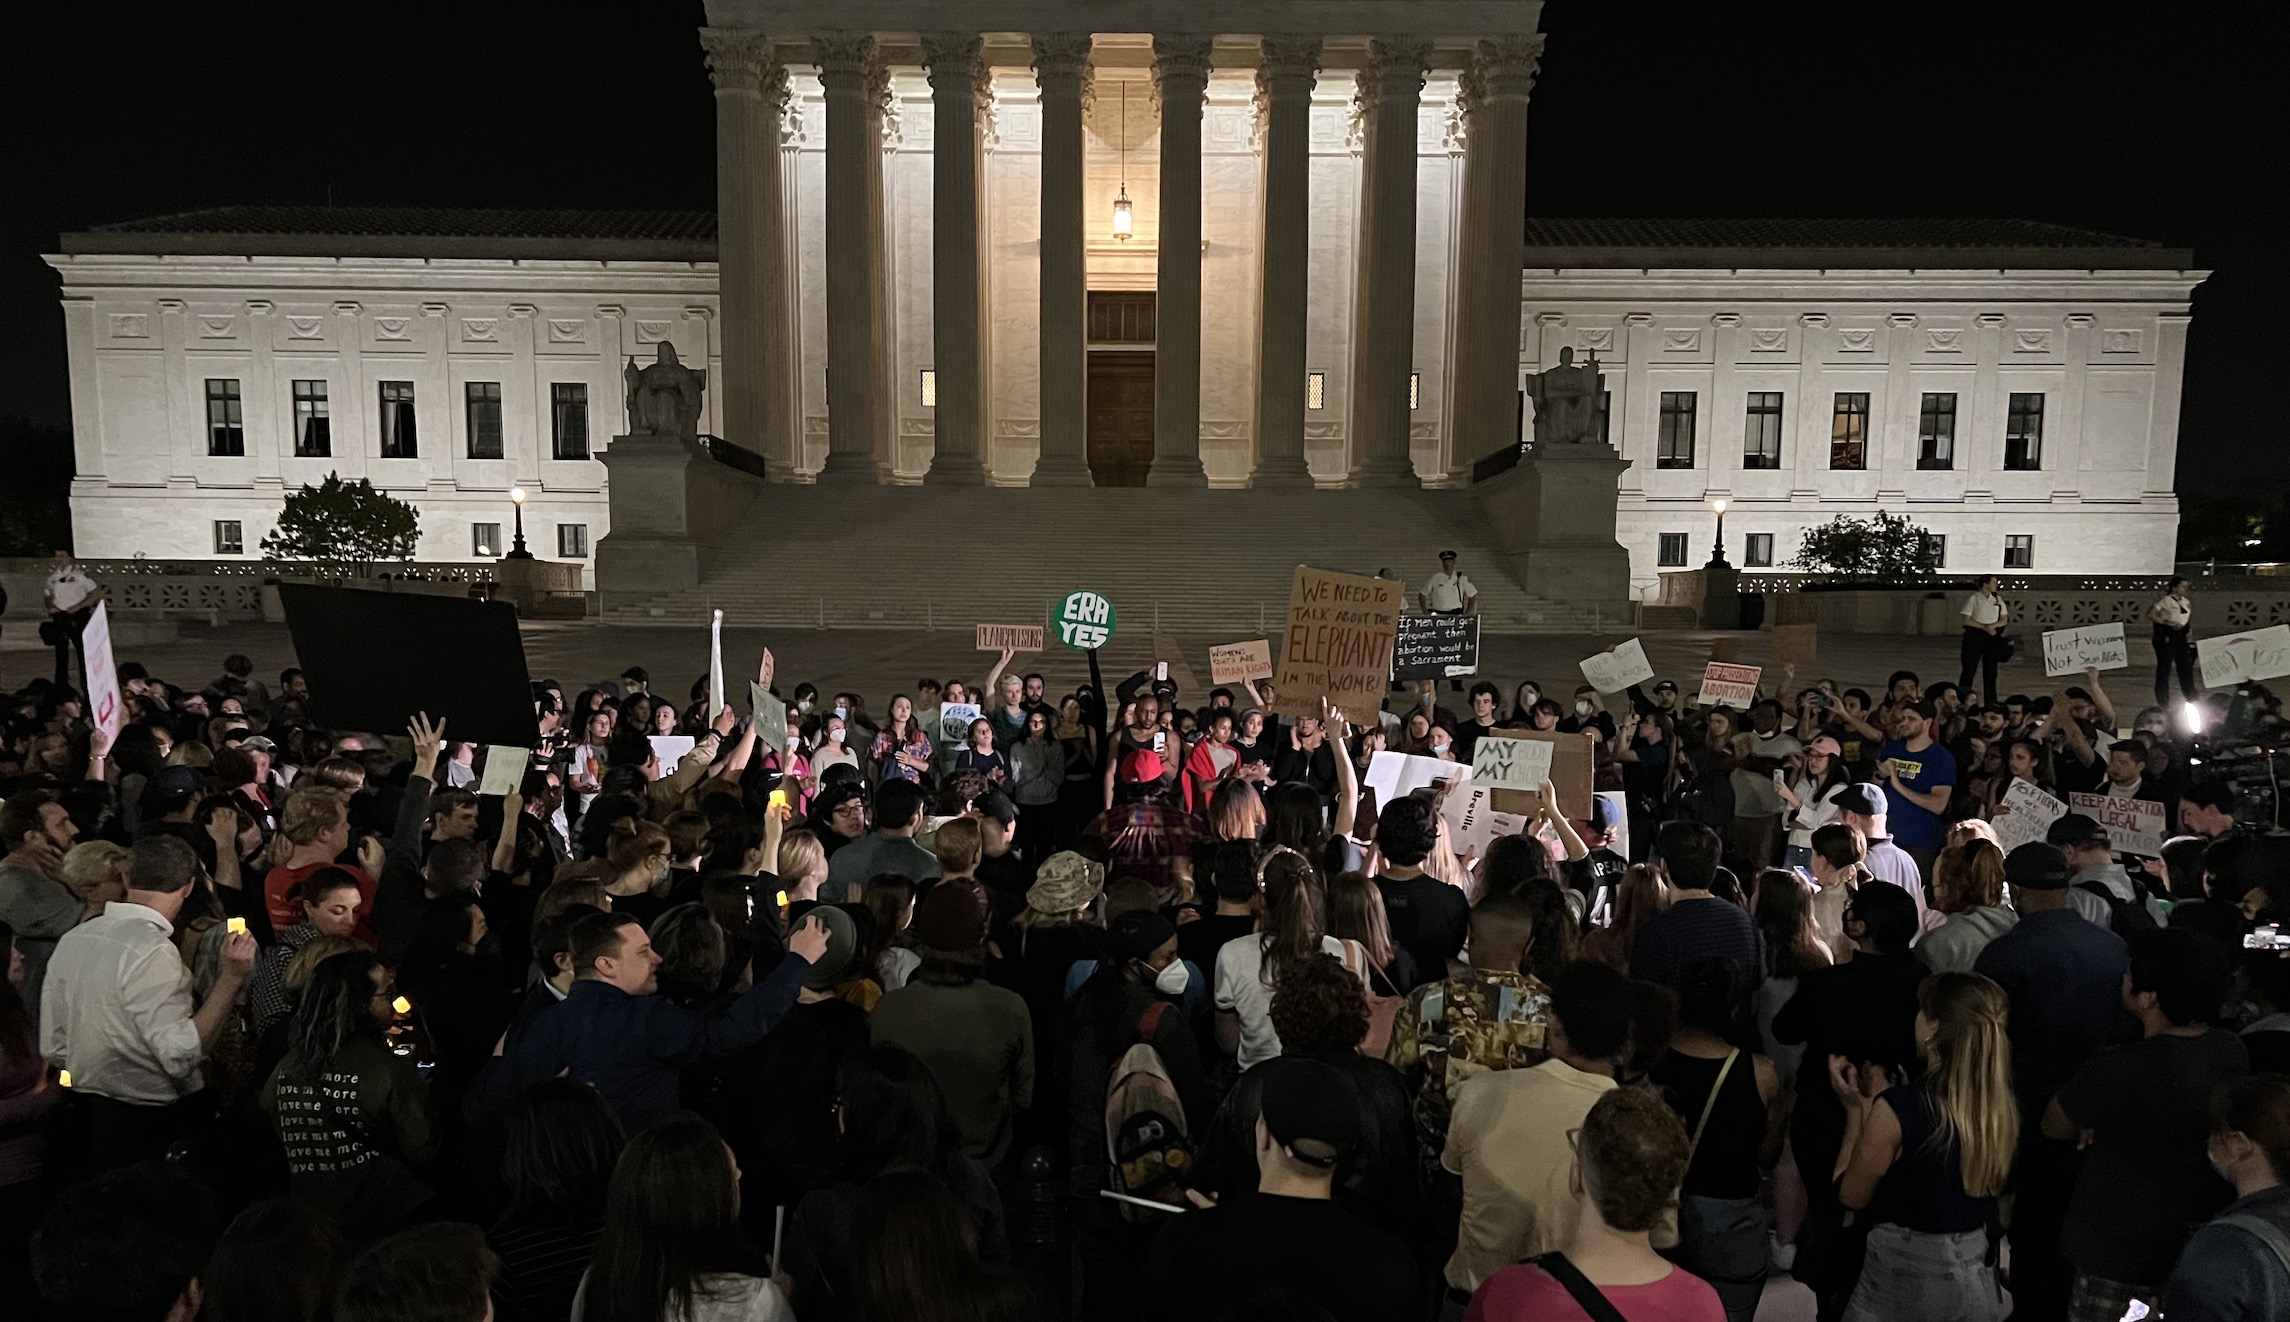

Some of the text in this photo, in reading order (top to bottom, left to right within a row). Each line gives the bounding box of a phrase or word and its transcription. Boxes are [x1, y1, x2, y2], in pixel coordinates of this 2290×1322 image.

[1301, 577, 1330, 603] WE
[1334, 584, 1371, 602] NEED
[1063, 592, 1110, 624] ERA
[1293, 607, 1392, 625] TALK ABOUT THE
[1398, 618, 1411, 631] If
[1436, 617, 1455, 627] could
[1059, 620, 1109, 648] YES
[1398, 627, 1466, 645] pregnant then
[2043, 632, 2081, 652] Trust
[1288, 625, 1394, 668] ELEPHANT
[1398, 641, 1474, 655] abortion would be
[1398, 658, 1405, 666] a
[2047, 656, 2072, 672] Not
[1283, 671, 1299, 685] IN
[1327, 669, 1380, 694] WOMB!
[1702, 682, 1754, 700] ABORTION
[1478, 741, 1518, 759] MY
[1474, 761, 1513, 780] MY
[2071, 793, 2105, 808] KEEP
[1461, 790, 1484, 831] Breville
[2099, 810, 2141, 832] LEGAL
[277, 1084, 298, 1095] love
[278, 1100, 359, 1115] love me ore
[281, 1115, 323, 1127] love me
[282, 1131, 308, 1142] love
[311, 1132, 328, 1141] me
[286, 1146, 311, 1158] love
[314, 1148, 331, 1156] me
[290, 1162, 314, 1173] love
[319, 1163, 336, 1171] me
